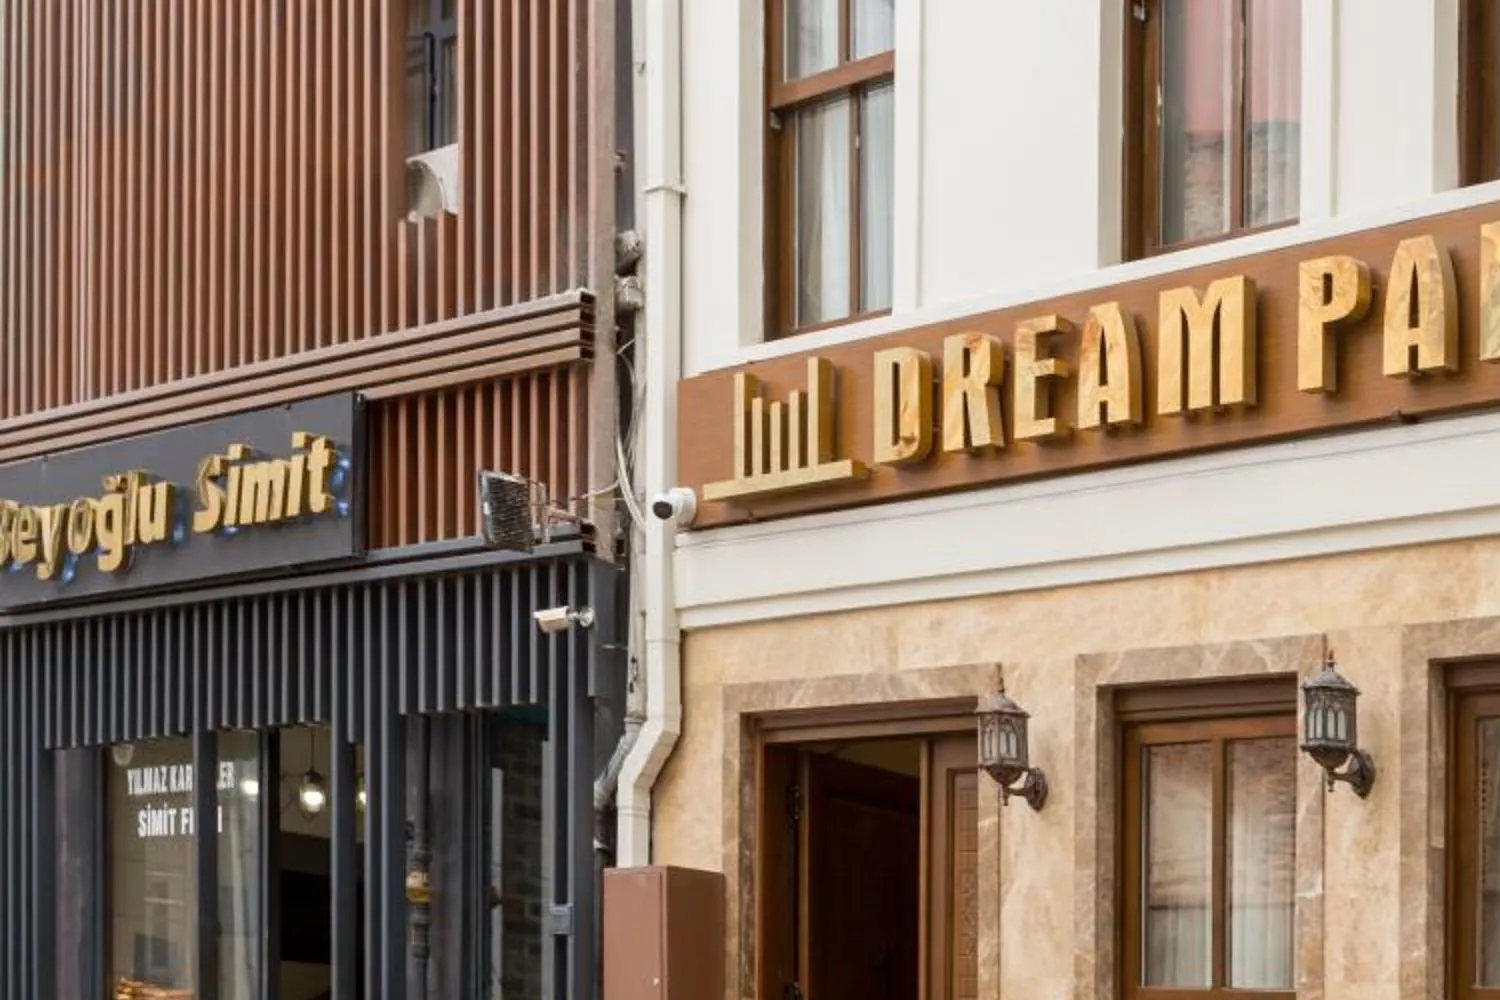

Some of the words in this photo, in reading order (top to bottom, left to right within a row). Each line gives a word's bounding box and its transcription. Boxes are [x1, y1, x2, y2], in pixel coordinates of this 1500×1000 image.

[873, 274, 1257, 465] DREAM
[193, 431, 335, 533] Simit
[127, 766, 168, 795] YILMAZ
[138, 802, 176, 837] SİMİT
